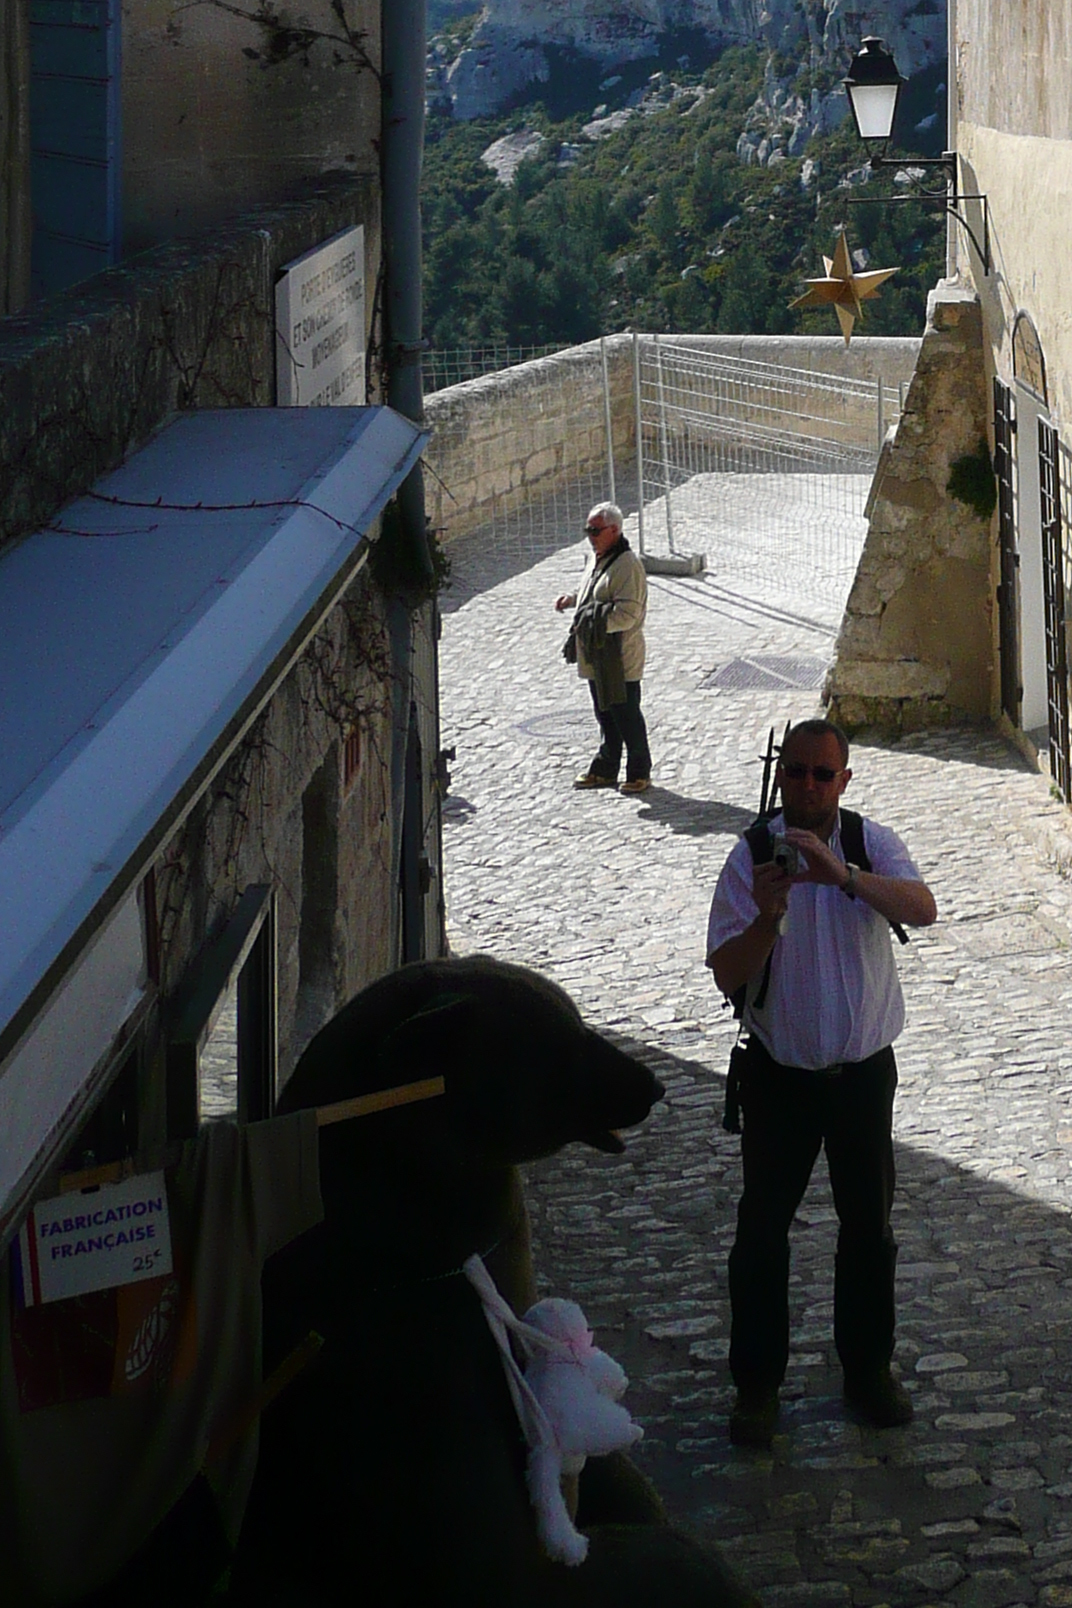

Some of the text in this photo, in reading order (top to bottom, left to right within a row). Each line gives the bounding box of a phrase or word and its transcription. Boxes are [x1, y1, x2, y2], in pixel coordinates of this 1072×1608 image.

[293, 322, 302, 349] ET
[40, 1197, 163, 1238] FABRICATION
[51, 1224, 156, 1260] FRANÇAISE
